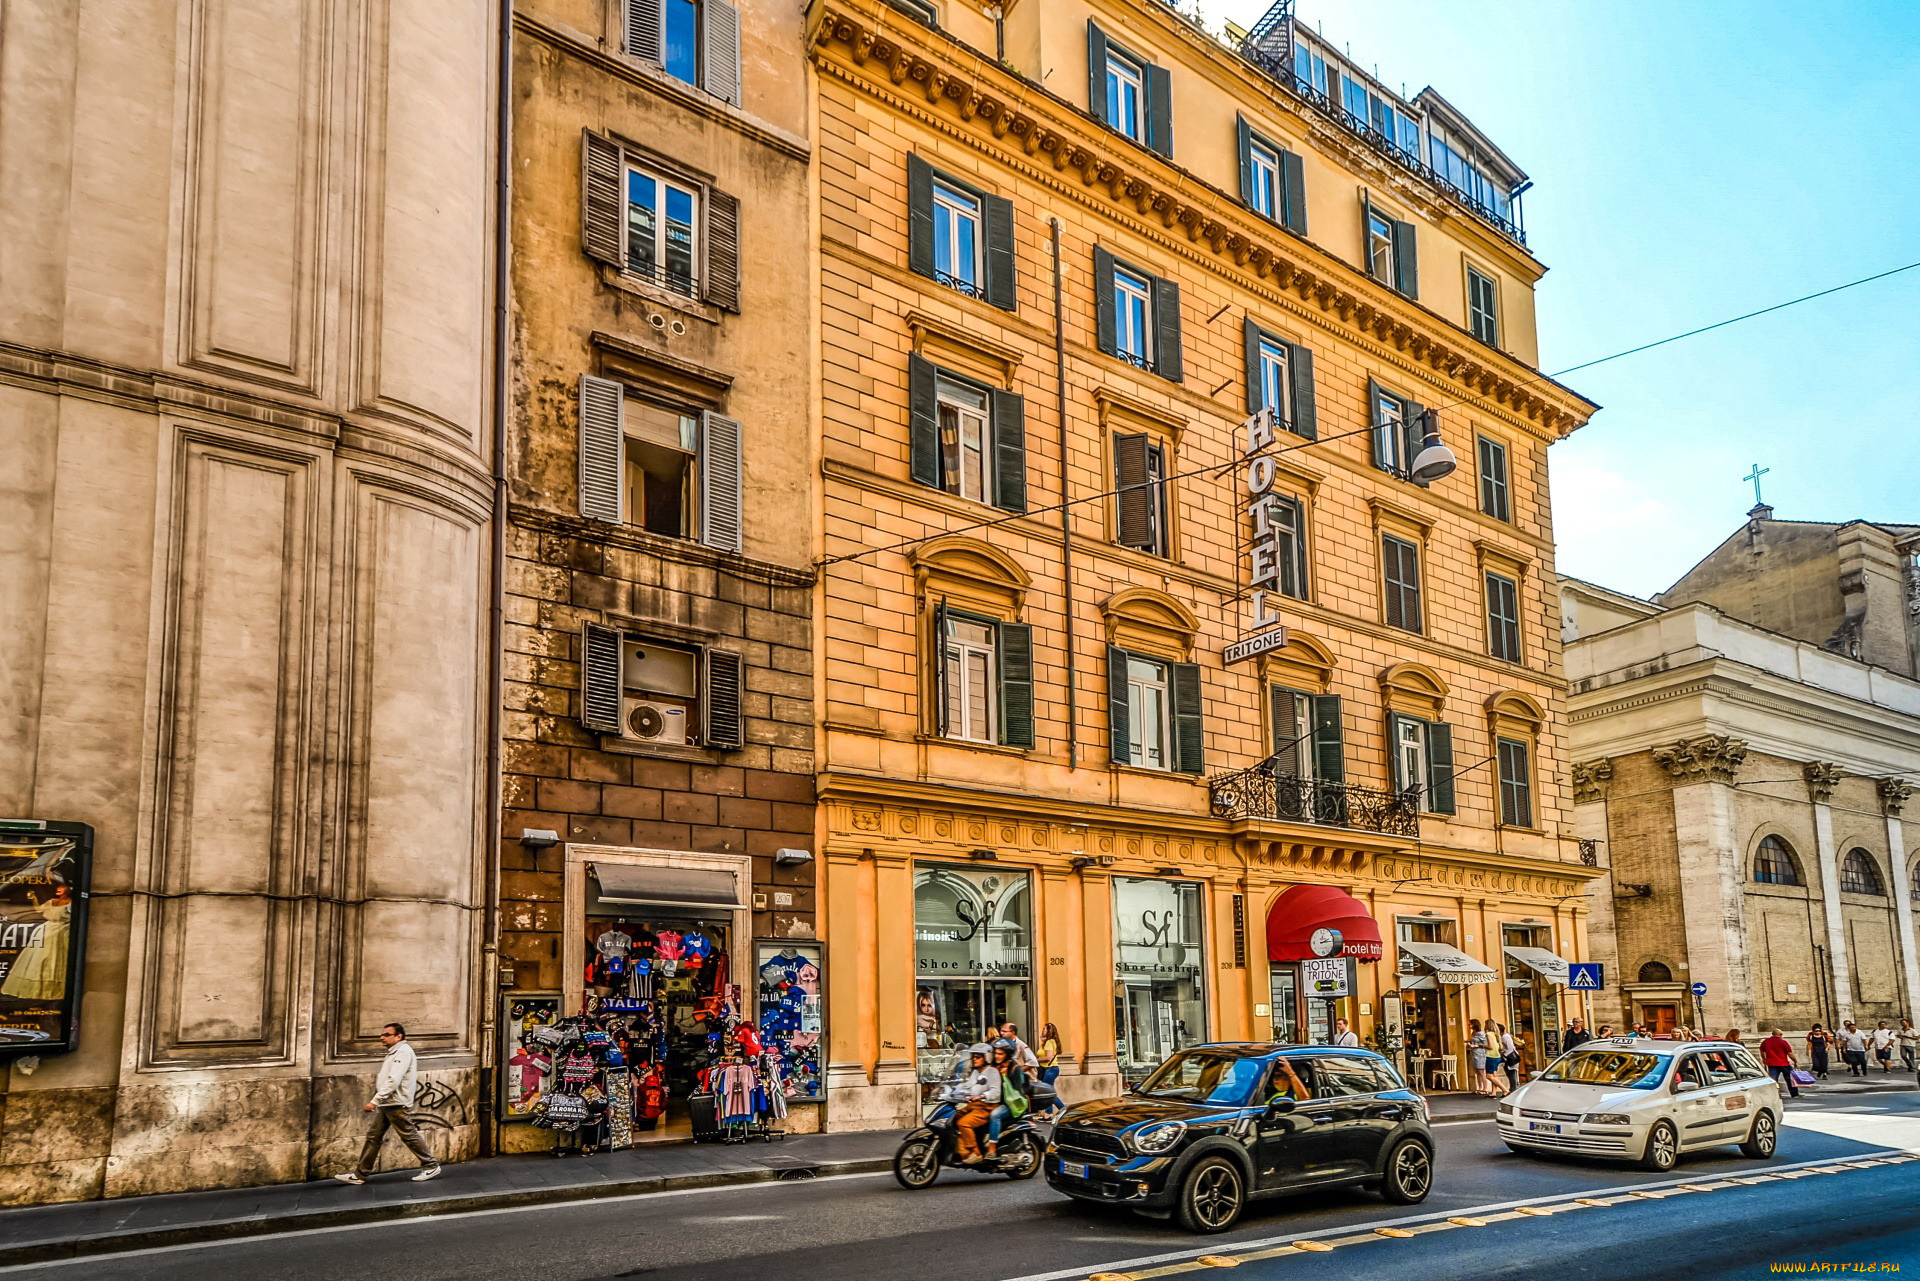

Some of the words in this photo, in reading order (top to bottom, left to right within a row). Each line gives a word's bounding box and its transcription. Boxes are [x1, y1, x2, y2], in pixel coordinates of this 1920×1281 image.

[1244, 405, 1280, 629] HOTEL
[1225, 632, 1281, 660] TRITONE
[776, 893, 791, 903] 207
[1343, 943, 1368, 954] hotel
[920, 959, 958, 969] Shoe
[969, 960, 1026, 970] fashion
[1050, 957, 1065, 966] 208
[1221, 962, 1233, 970] 209
[1303, 960, 1338, 972] HOTEL
[1115, 963, 1146, 972] Shoe
[1154, 964, 1200, 973] fashion
[1308, 970, 1344, 981] TRITONE
[1461, 973, 1466, 983] &
